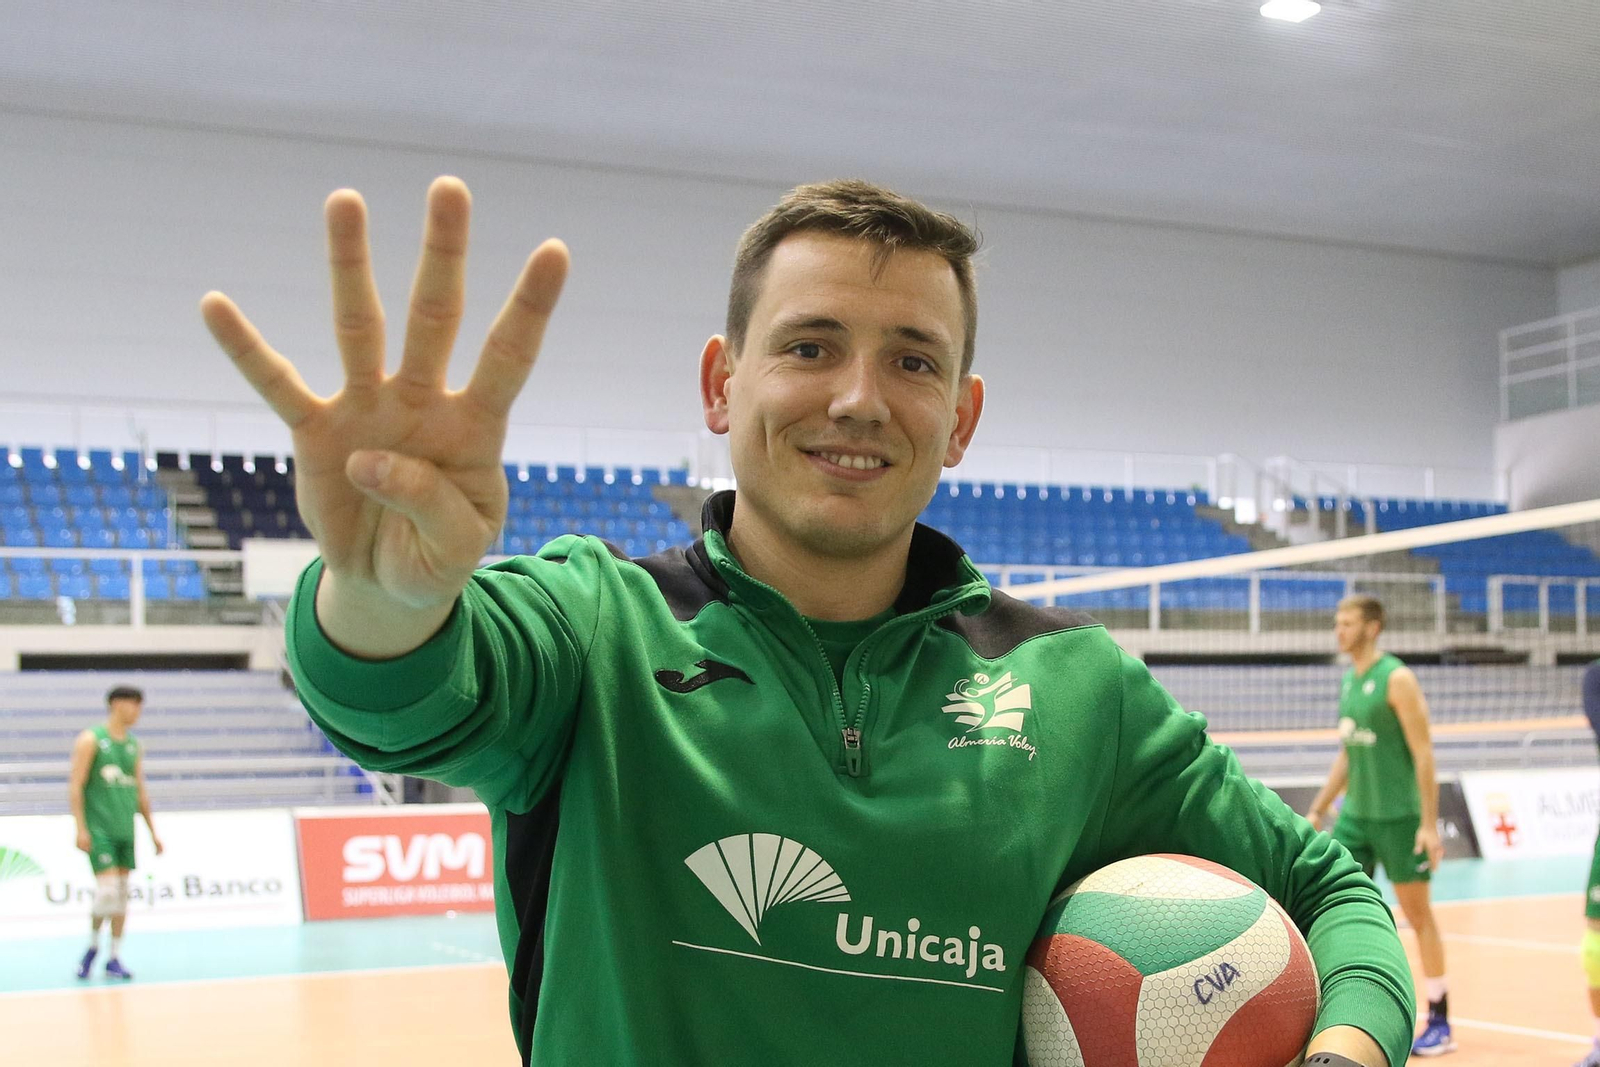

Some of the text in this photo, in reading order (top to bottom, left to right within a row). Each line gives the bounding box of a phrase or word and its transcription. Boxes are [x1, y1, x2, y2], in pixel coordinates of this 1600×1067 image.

[1008, 735, 1037, 761] Voley
[342, 832, 486, 883] SVM
[45, 873, 283, 906] Unaja Banco
[836, 913, 1006, 978] Unicaja
[1193, 962, 1241, 1005] CVA
